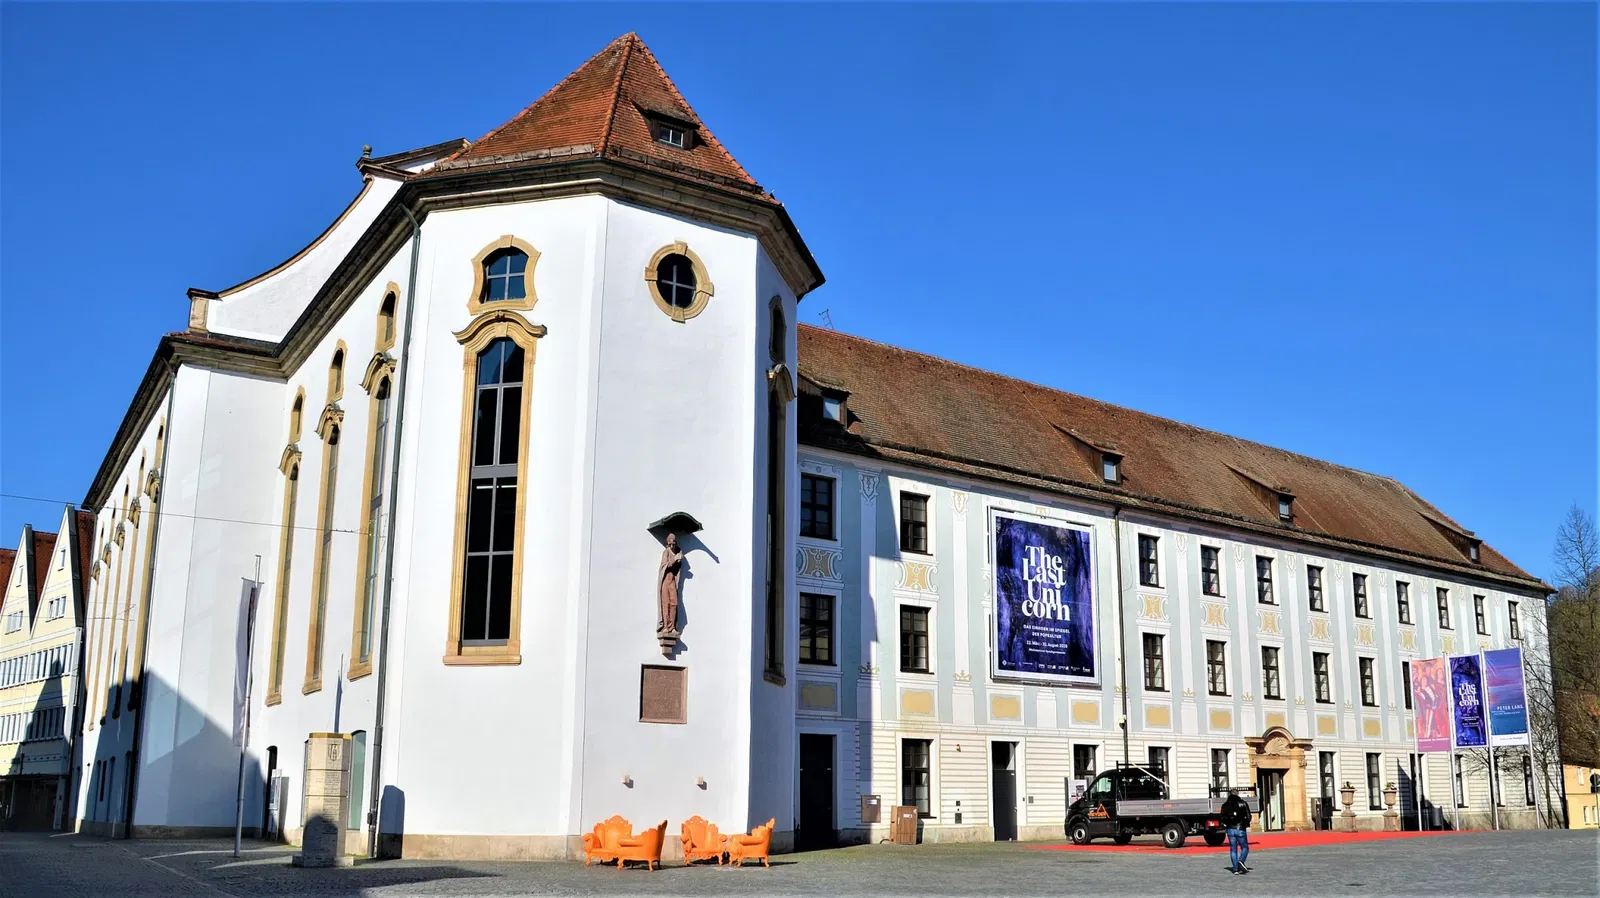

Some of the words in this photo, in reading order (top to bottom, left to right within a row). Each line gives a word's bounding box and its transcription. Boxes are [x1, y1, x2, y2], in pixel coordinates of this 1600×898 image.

[1025, 545, 1063, 570] The
[1022, 557, 1067, 586] Last
[1027, 580, 1062, 605] Uni
[1021, 599, 1071, 622] corn
